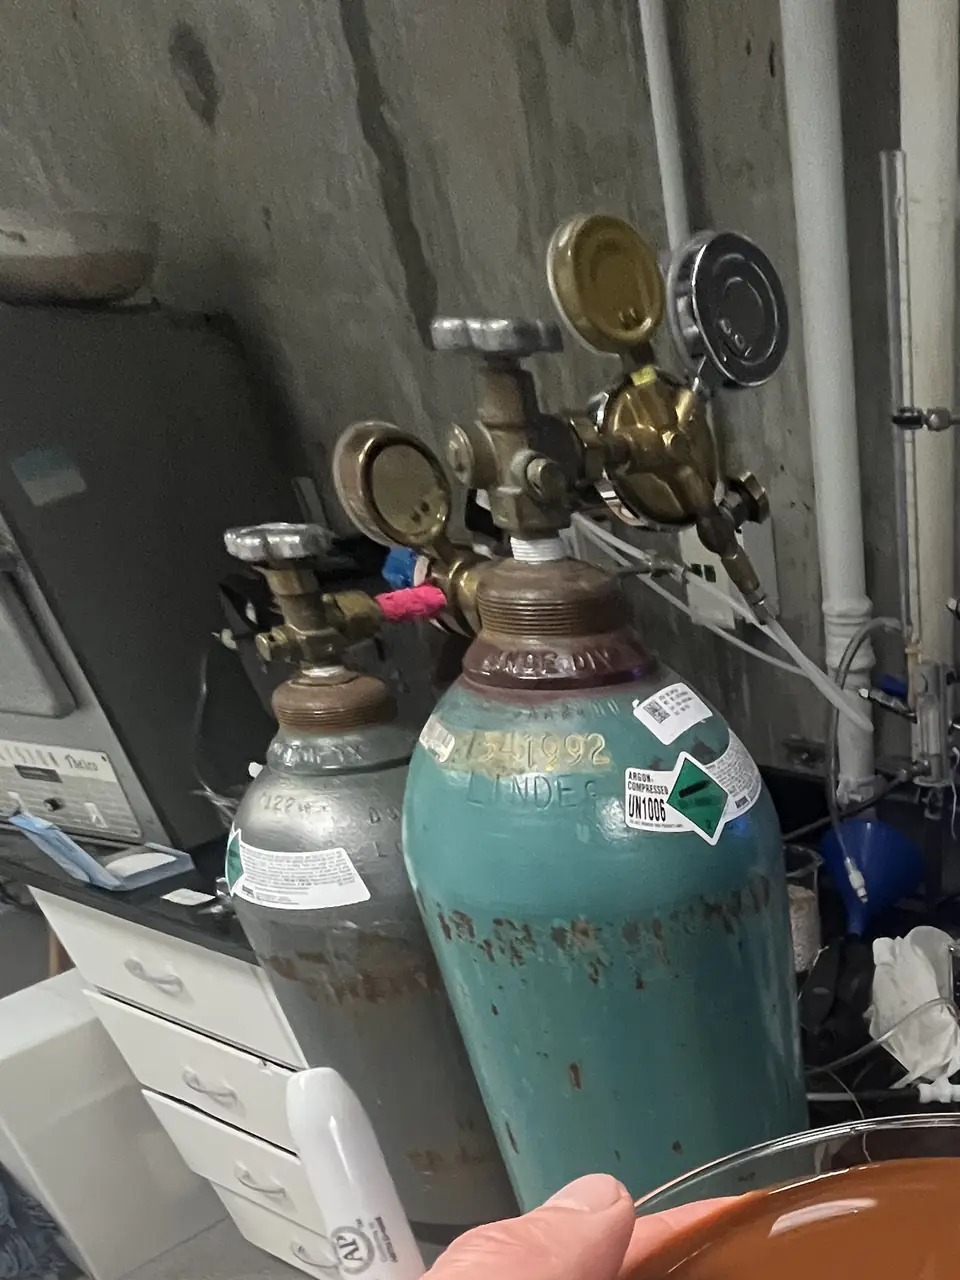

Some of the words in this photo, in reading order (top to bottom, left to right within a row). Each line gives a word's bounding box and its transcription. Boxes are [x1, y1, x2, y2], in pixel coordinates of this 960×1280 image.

[627, 780, 669, 796] COMPRESSED
[628, 794, 666, 822] UN1006
[335, 1235, 364, 1261] AP
